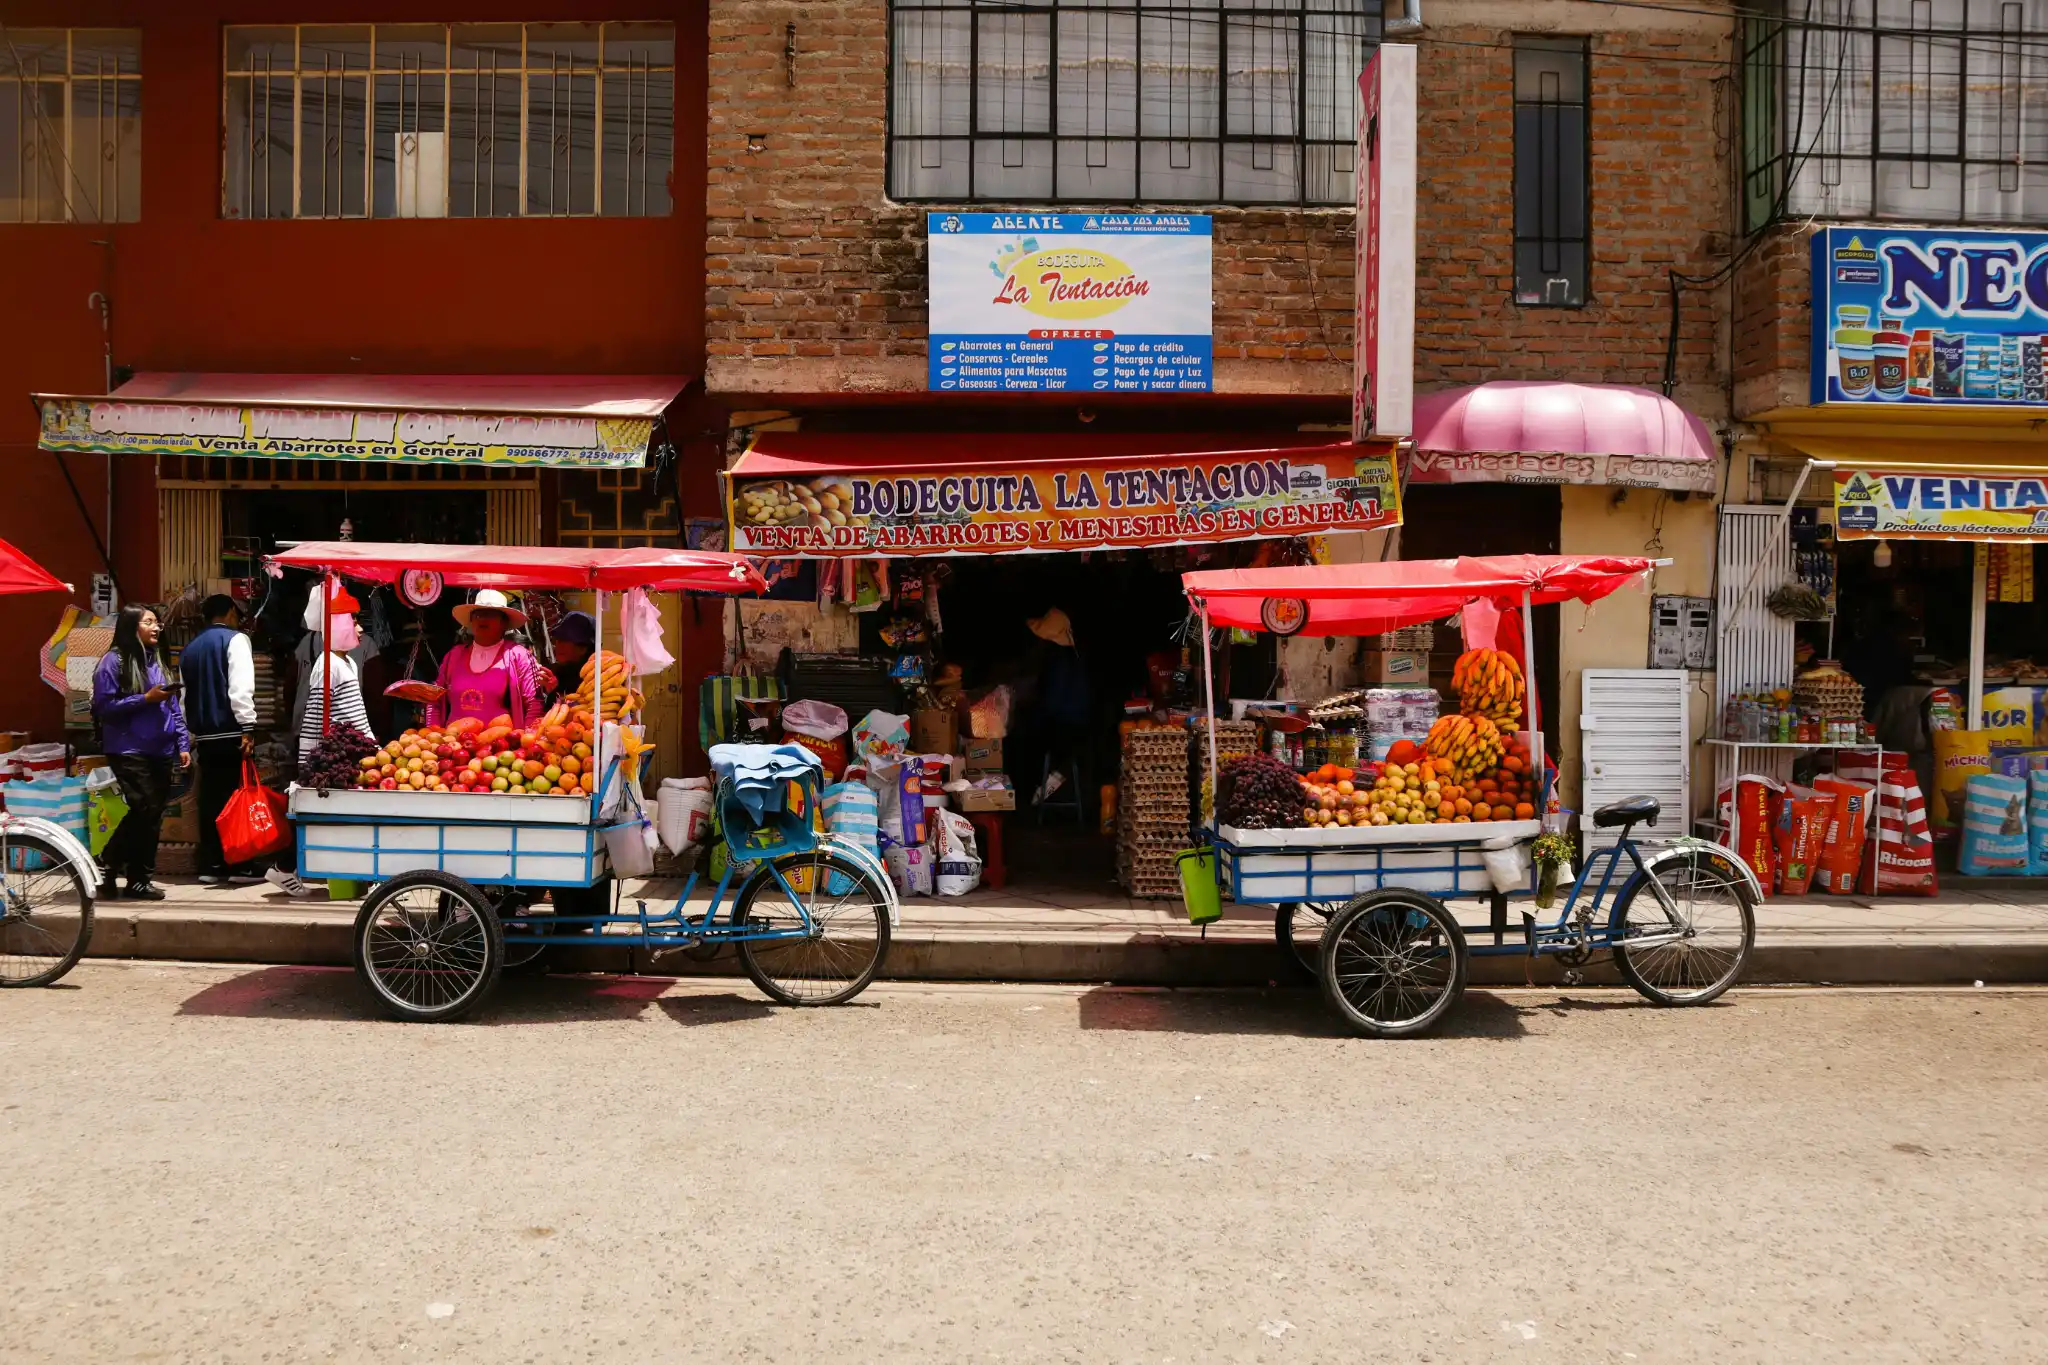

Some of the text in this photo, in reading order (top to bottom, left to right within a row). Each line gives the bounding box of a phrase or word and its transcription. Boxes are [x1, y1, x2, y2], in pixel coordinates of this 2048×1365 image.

[991, 216, 1064, 230] AGENTE
[1037, 254, 1105, 268] BODEGUITA
[992, 272, 1150, 304] La Tentación
[959, 341, 1054, 351] Abarrotes en General
[1113, 342, 1184, 354] Pago de crédito
[959, 353, 1049, 364] Conservas Cereales
[1113, 354, 1202, 366] Recargas de celular
[959, 366, 1068, 378] Alimentos para Mascotas
[1113, 367, 1202, 379] Pago de Agua y Luz
[959, 378, 1067, 389] Gaseosas Cerveza Licor
[1113, 379, 1207, 391] Poner y sacar dinero
[198, 438, 485, 459] Venta Abarrotes en General
[1412, 450, 1595, 476] Variedades
[850, 458, 1291, 517] BODEGUITA LA TENTACION
[1326, 479, 1358, 491] GLORIA
[741, 498, 1384, 549] VENTA DE ABARROTES Y MENESTRAS EN GENERAL
[1883, 521, 1958, 533] Productos
[1961, 521, 2014, 534] lácteos
[1981, 709, 2027, 729] HOR
[1797, 814, 1808, 860] mimaskot
[1879, 851, 1933, 868] Ricocan
